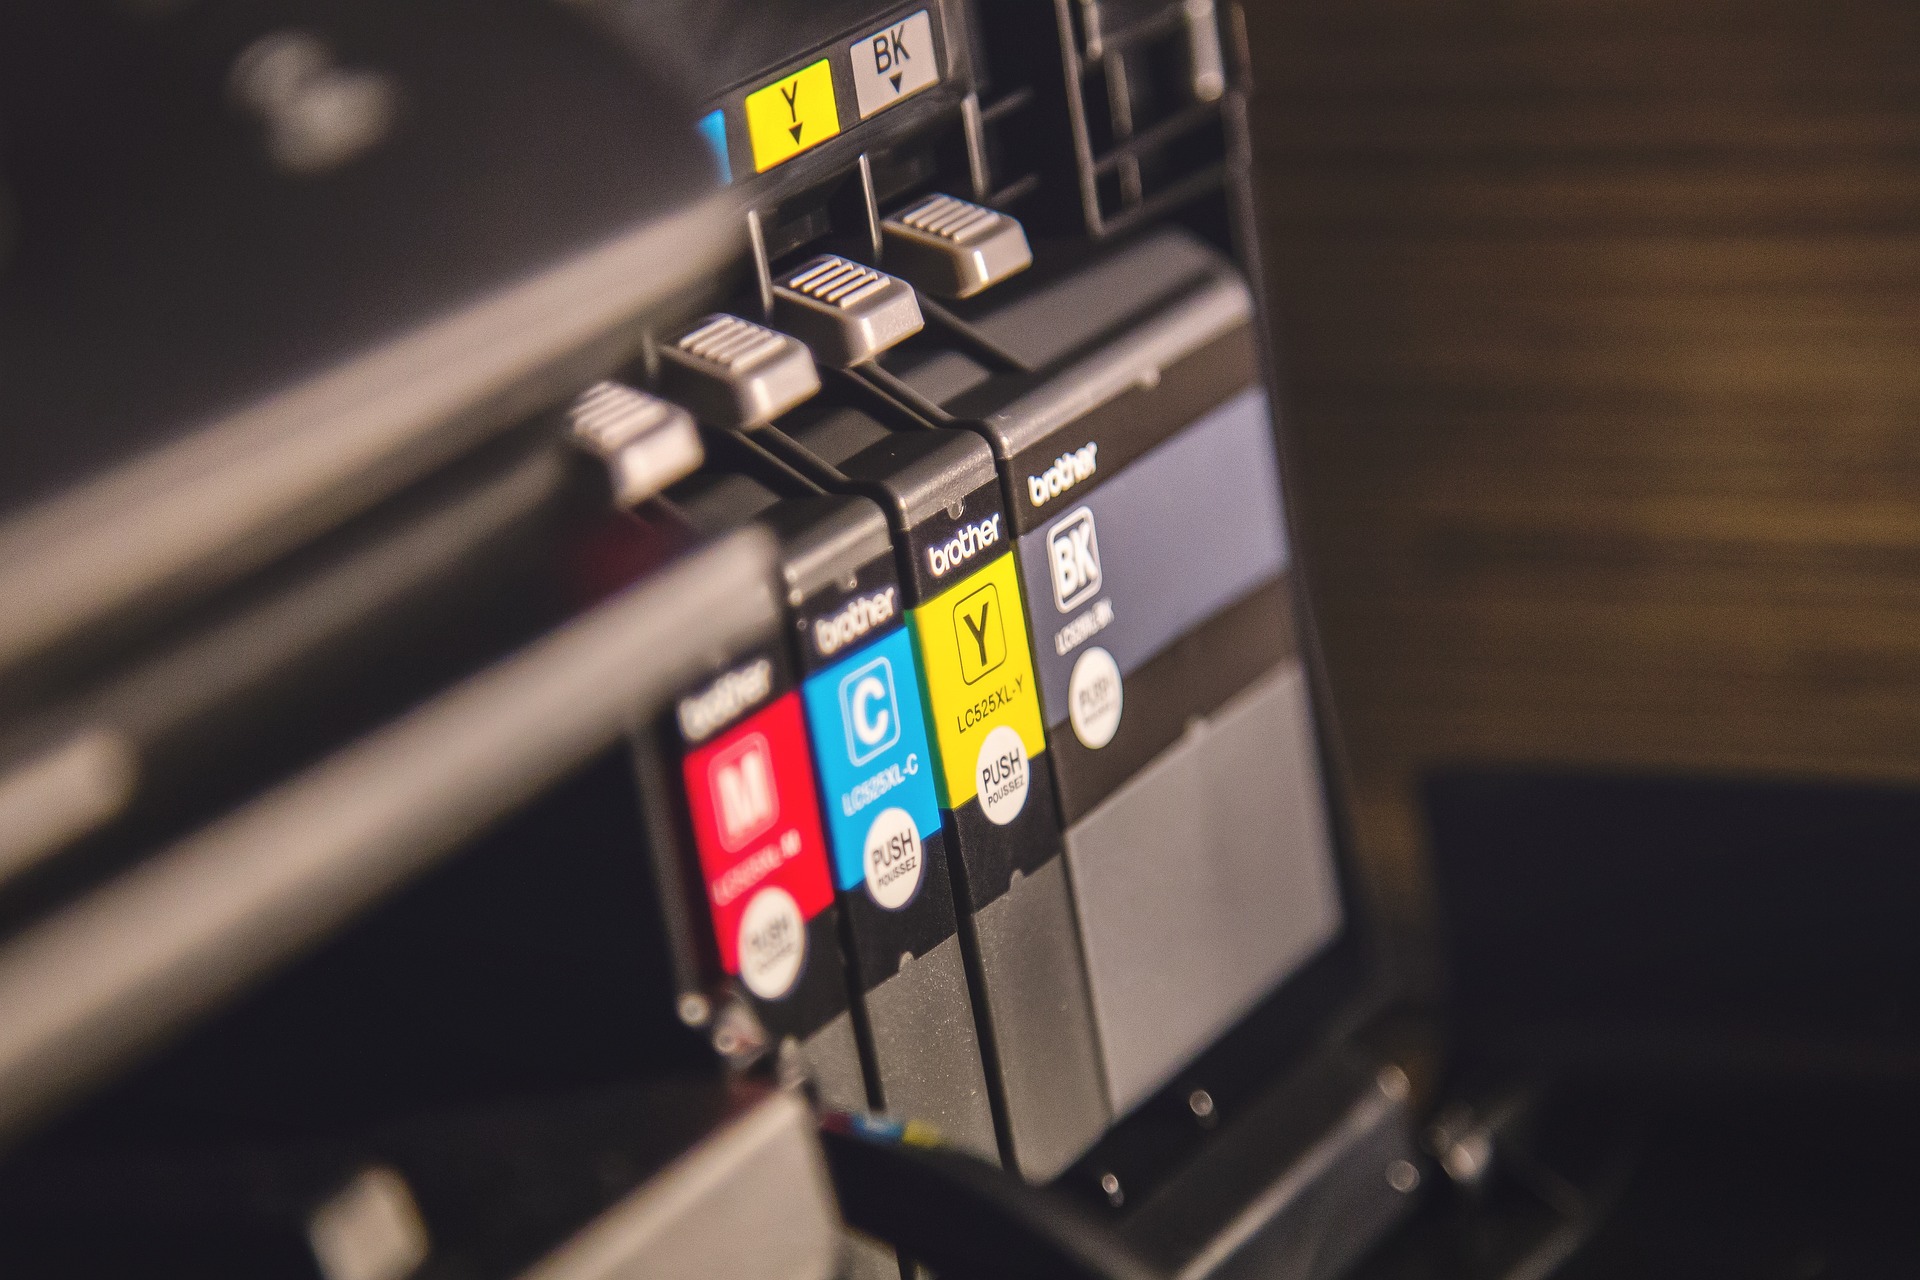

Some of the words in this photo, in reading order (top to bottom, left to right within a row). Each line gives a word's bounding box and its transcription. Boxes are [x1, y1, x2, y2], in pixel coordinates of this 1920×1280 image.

[873, 24, 910, 74] BK
[781, 81, 798, 122] Y
[1028, 442, 1098, 507] brother
[930, 514, 1001, 577] brother
[1054, 522, 1098, 600] BK
[814, 587, 895, 656] brother
[963, 603, 990, 667] Y
[852, 676, 888, 745] C
[957, 674, 1025, 734] LC525XL-Y
[716, 757, 767, 831] M
[842, 753, 919, 817] LC525XL-C
[982, 748, 1023, 792] PUSH
[987, 775, 1025, 808] POUSSEZ
[871, 828, 914, 871] PUSH
